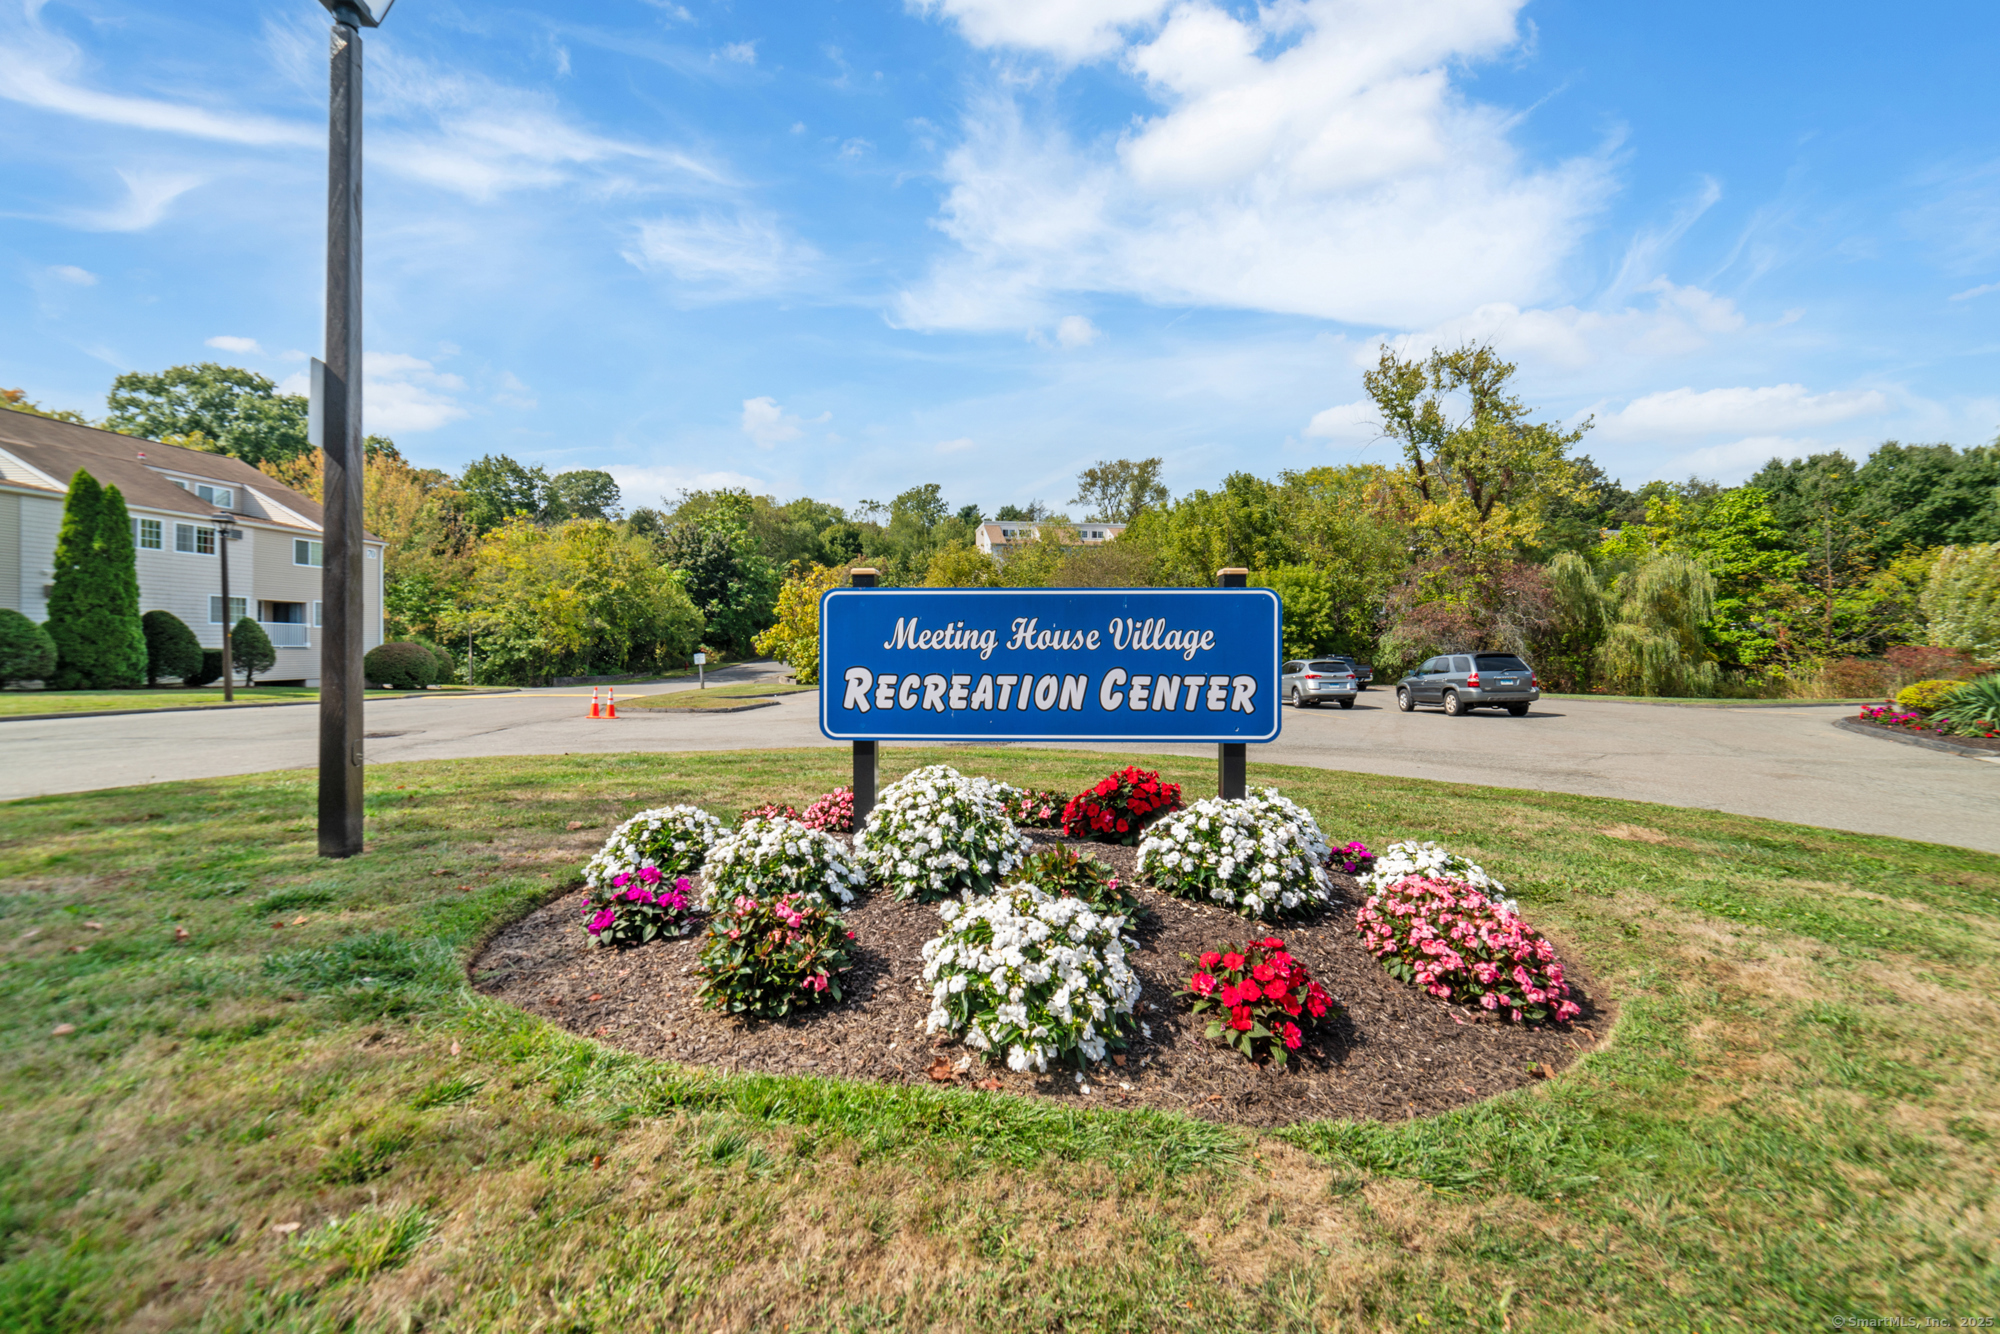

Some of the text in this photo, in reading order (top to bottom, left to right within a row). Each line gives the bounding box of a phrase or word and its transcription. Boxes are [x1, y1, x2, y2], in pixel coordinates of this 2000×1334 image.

[883, 617, 1216, 661] Meeting House Village
[843, 666, 1257, 714] RECREATION CENTER
